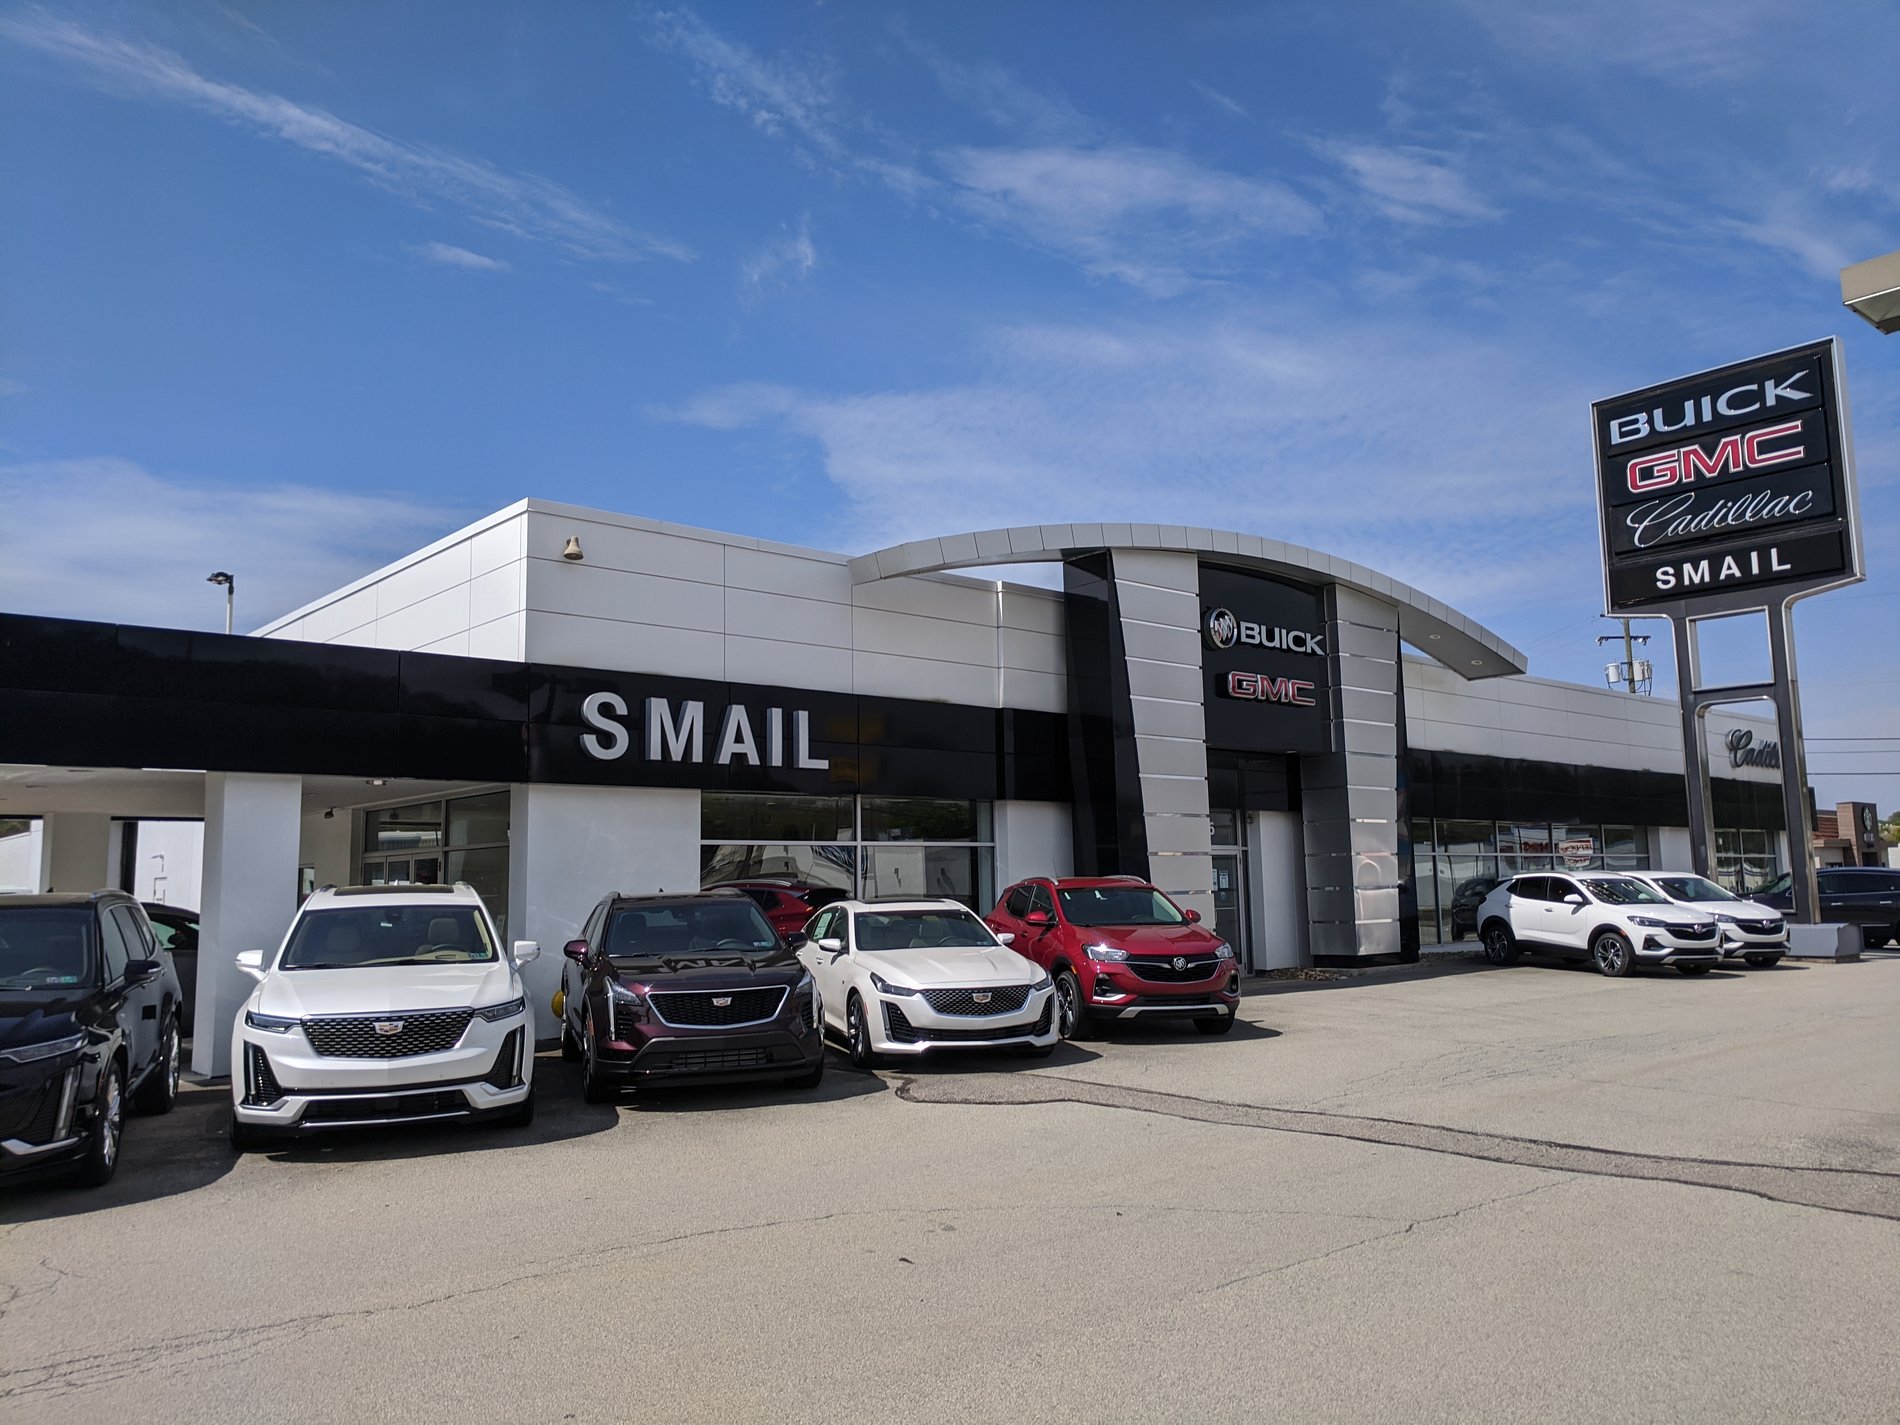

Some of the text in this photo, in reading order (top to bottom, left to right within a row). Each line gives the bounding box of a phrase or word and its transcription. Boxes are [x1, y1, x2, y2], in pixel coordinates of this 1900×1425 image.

[1609, 369, 1815, 445] BUICK
[1627, 420, 1804, 493] GMC
[1625, 489, 1813, 548] Cadillac
[1656, 548, 1791, 589] SMAIL
[1240, 621, 1325, 655] BUICK
[1228, 671, 1315, 705] GMC
[580, 692, 829, 769] SMAIL
